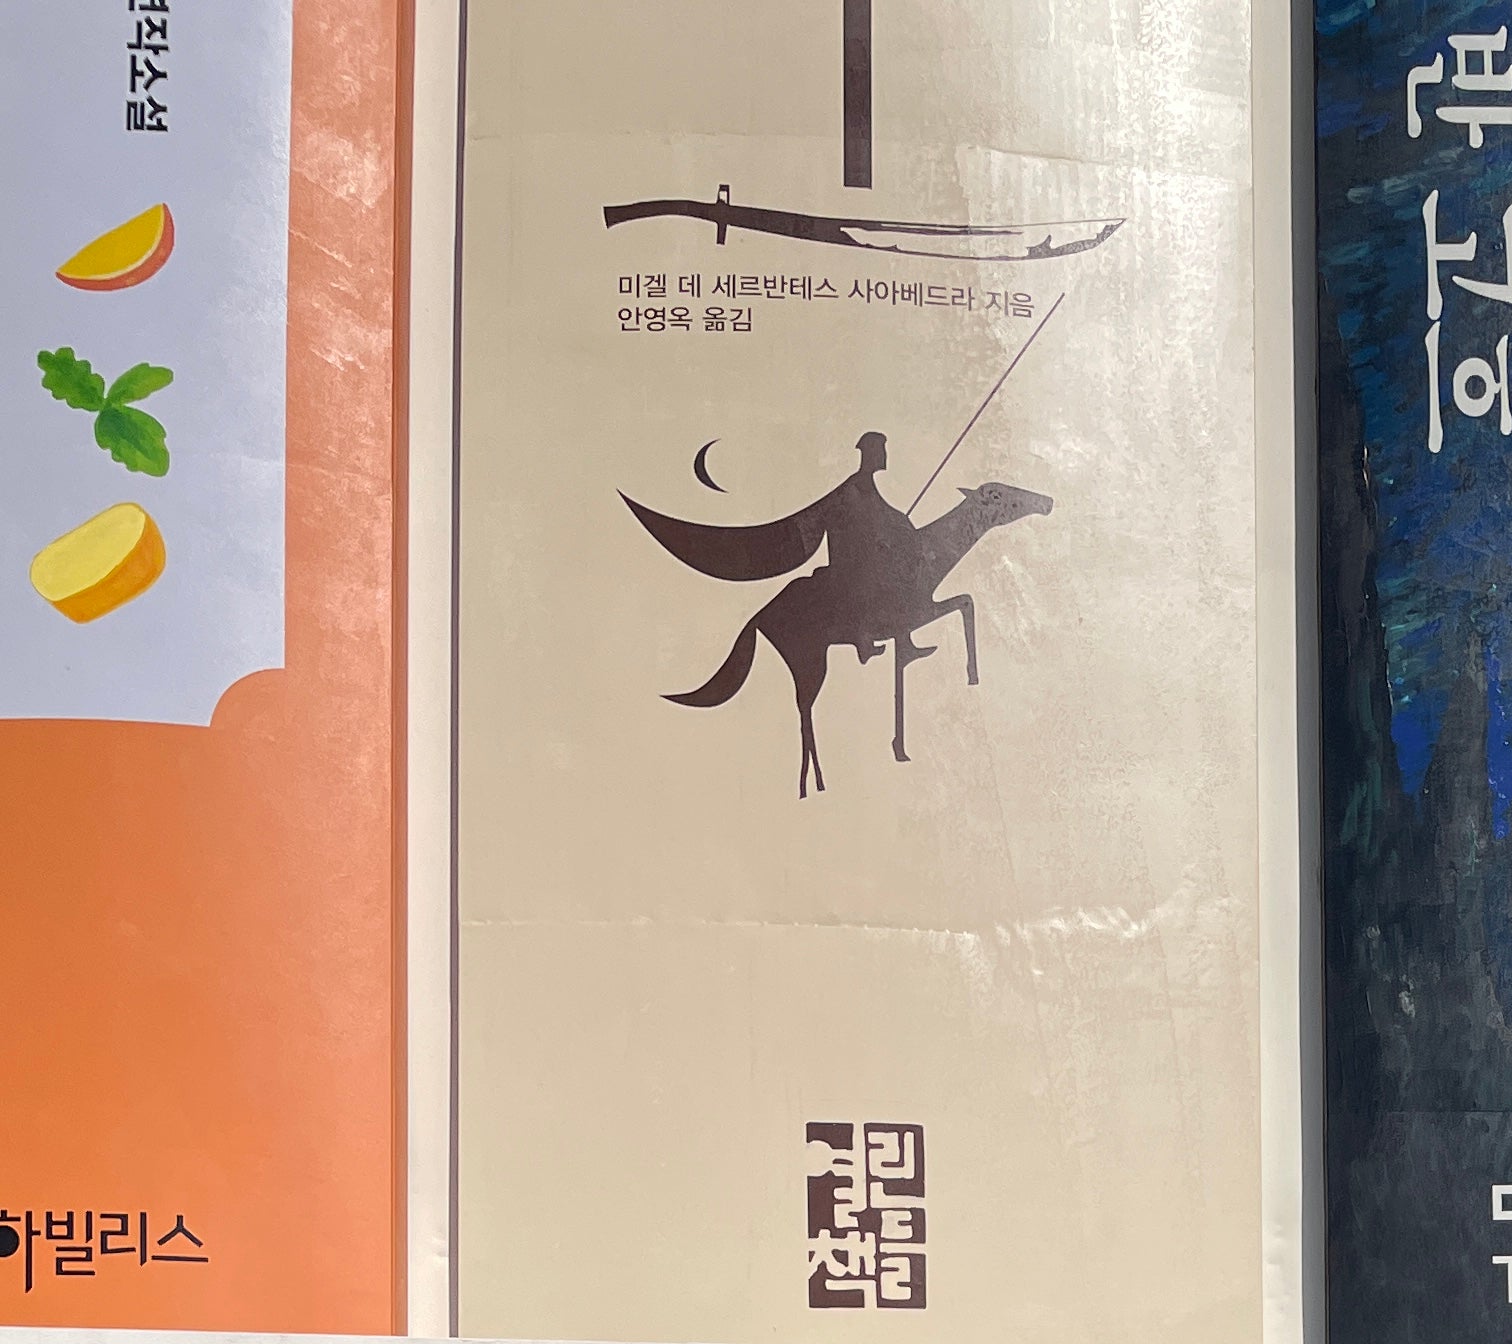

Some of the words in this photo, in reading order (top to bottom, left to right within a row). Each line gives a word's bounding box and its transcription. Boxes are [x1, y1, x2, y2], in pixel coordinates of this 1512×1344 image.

[617, 273, 667, 300] 미겔
[678, 273, 702, 299] 데
[711, 274, 839, 301] 세르반테스
[847, 278, 975, 312] 사아베드라
[983, 290, 1036, 319] 지음
[617, 306, 693, 333] 안영옥
[702, 306, 753, 333] 옮김
